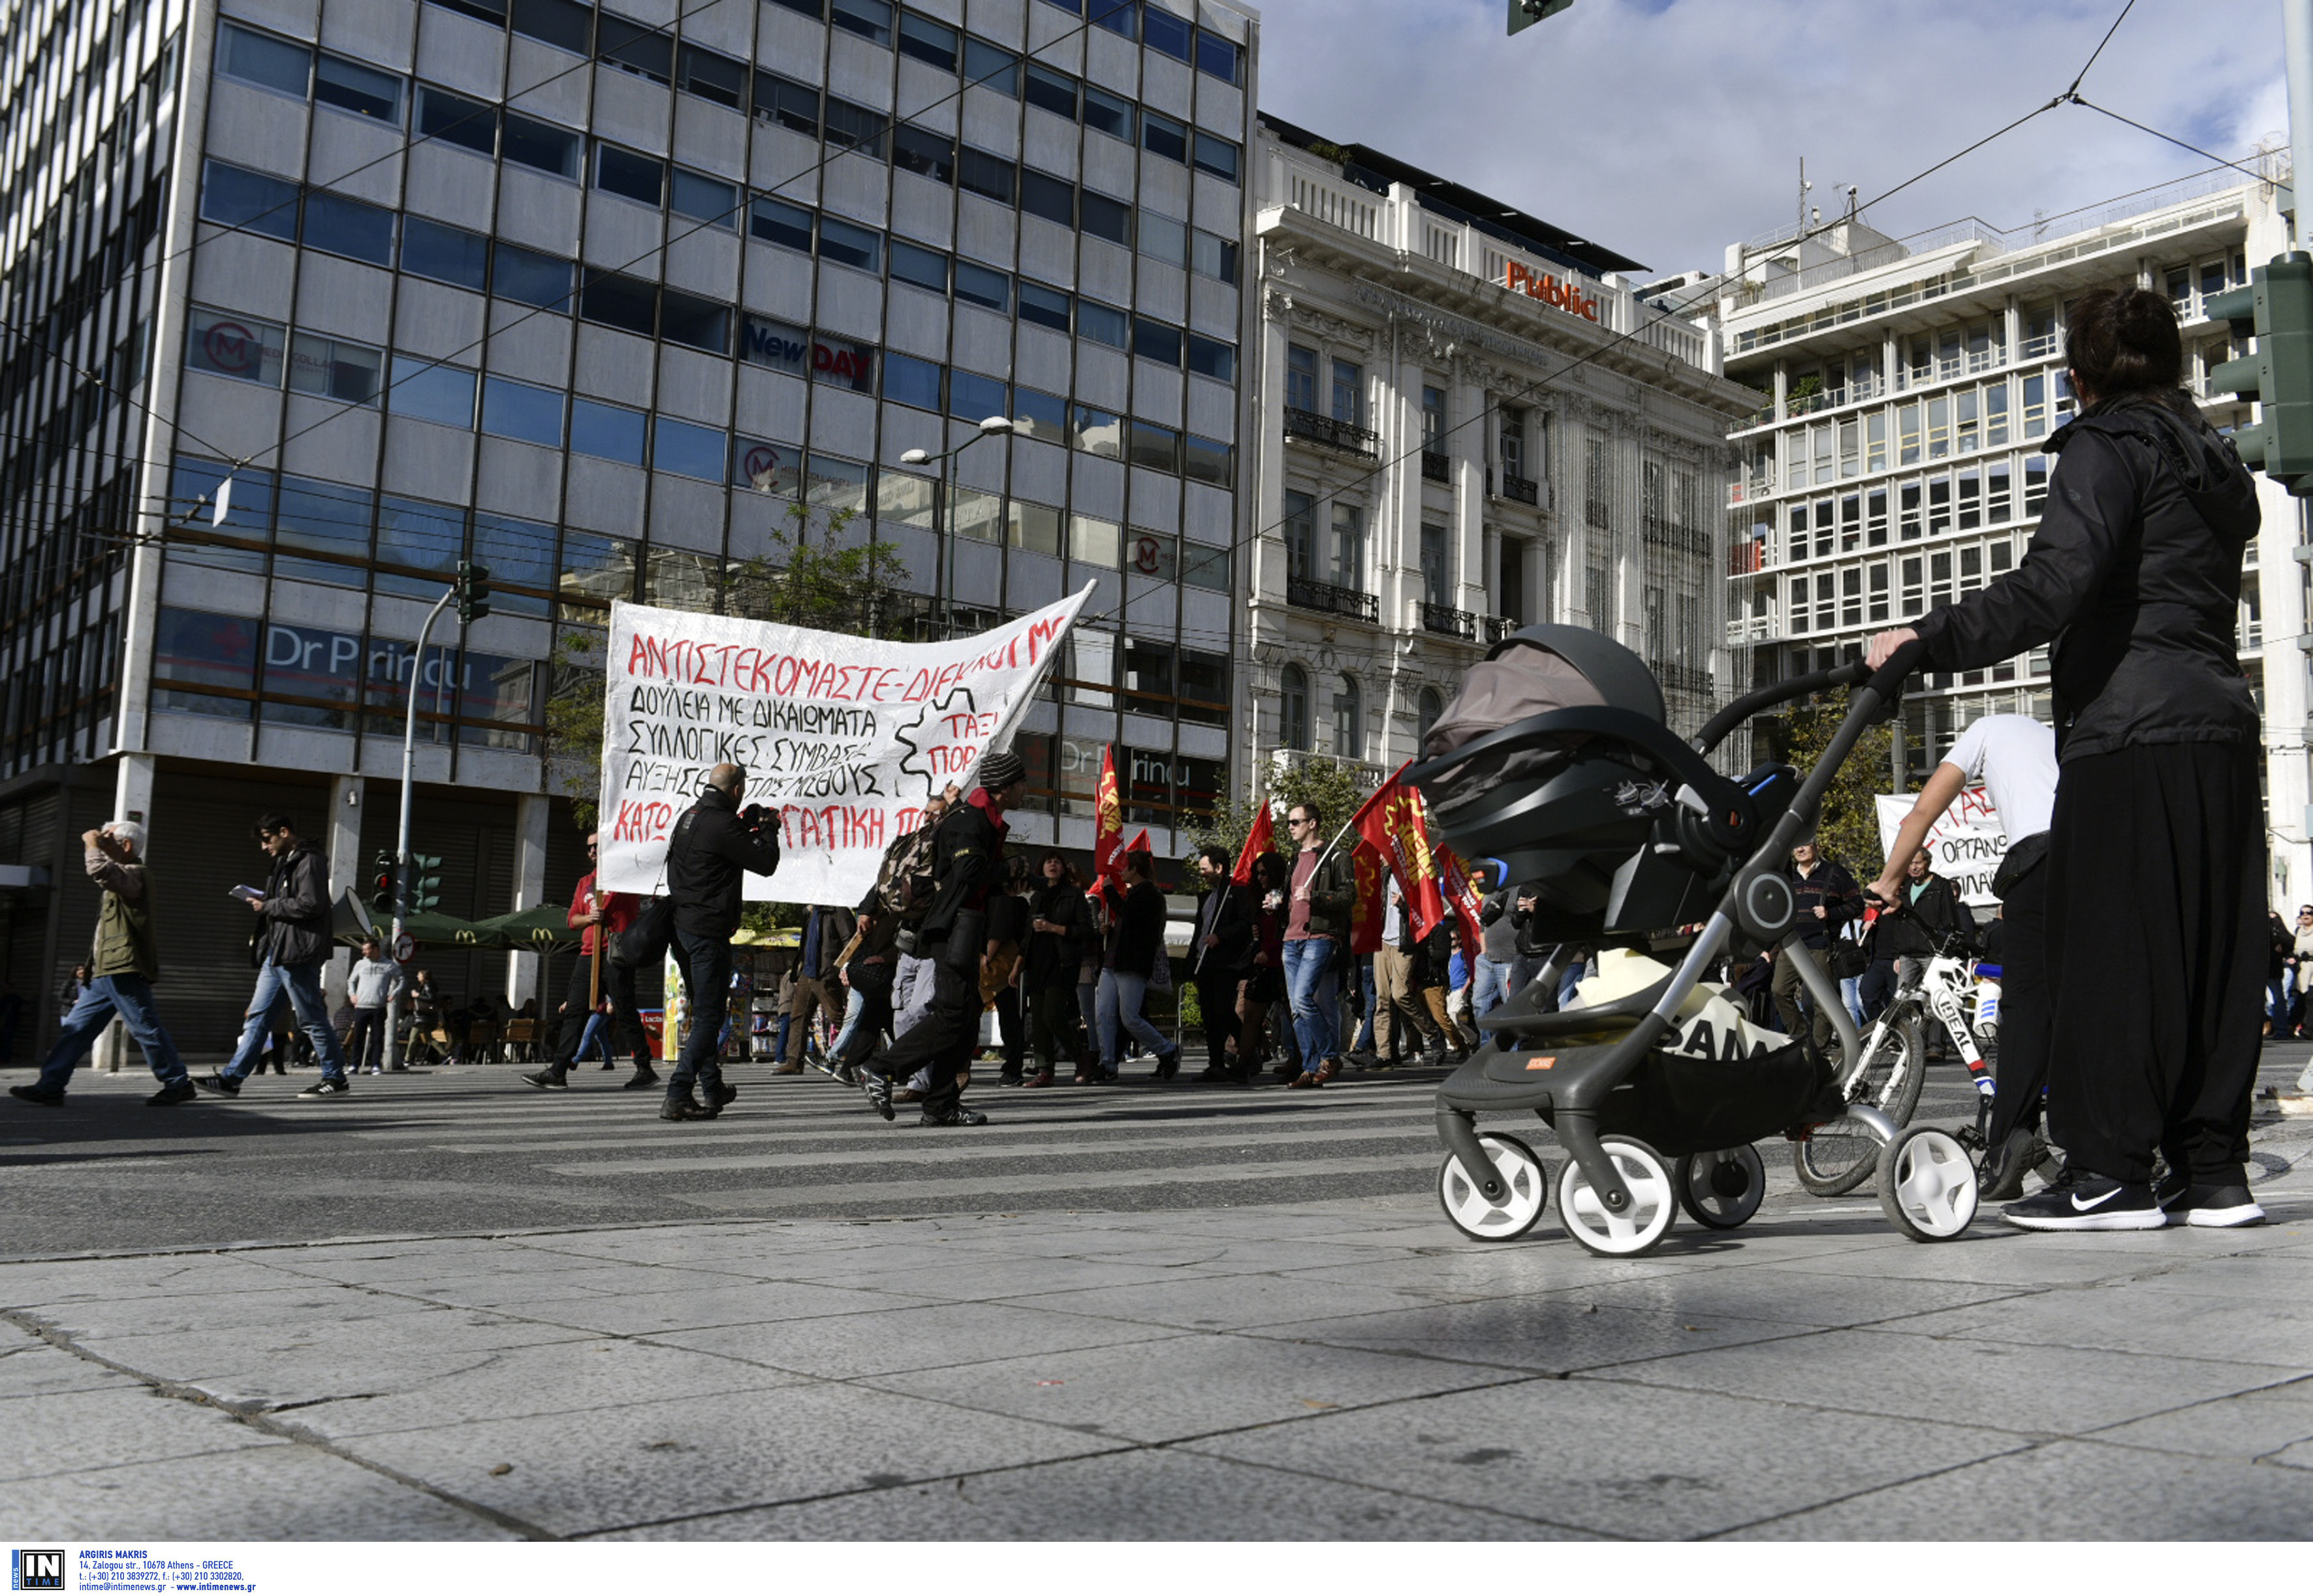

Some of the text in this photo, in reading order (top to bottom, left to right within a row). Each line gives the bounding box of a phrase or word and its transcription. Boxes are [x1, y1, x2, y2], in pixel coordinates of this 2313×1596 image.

[1507, 261, 1597, 322] Public
[745, 322, 871, 381] New DAY
[266, 626, 309, 669] Dr
[630, 686, 876, 738] ΔΟΥΛΕΙΑ ΜΕ ΔΙΚΑΙΩΜΑΤΑ
[628, 720, 766, 769] ΣΥΛΛΟΓΙΚΕΣ
[926, 744, 977, 775] ΠΟΡ
[1062, 741, 1092, 774] Dr
[625, 760, 712, 799] ΑΥΞΗΣΕ
[614, 799, 672, 843] ΚΑΤΩ
[1942, 835, 2007, 863] ΟΡΓΑΝΩ
